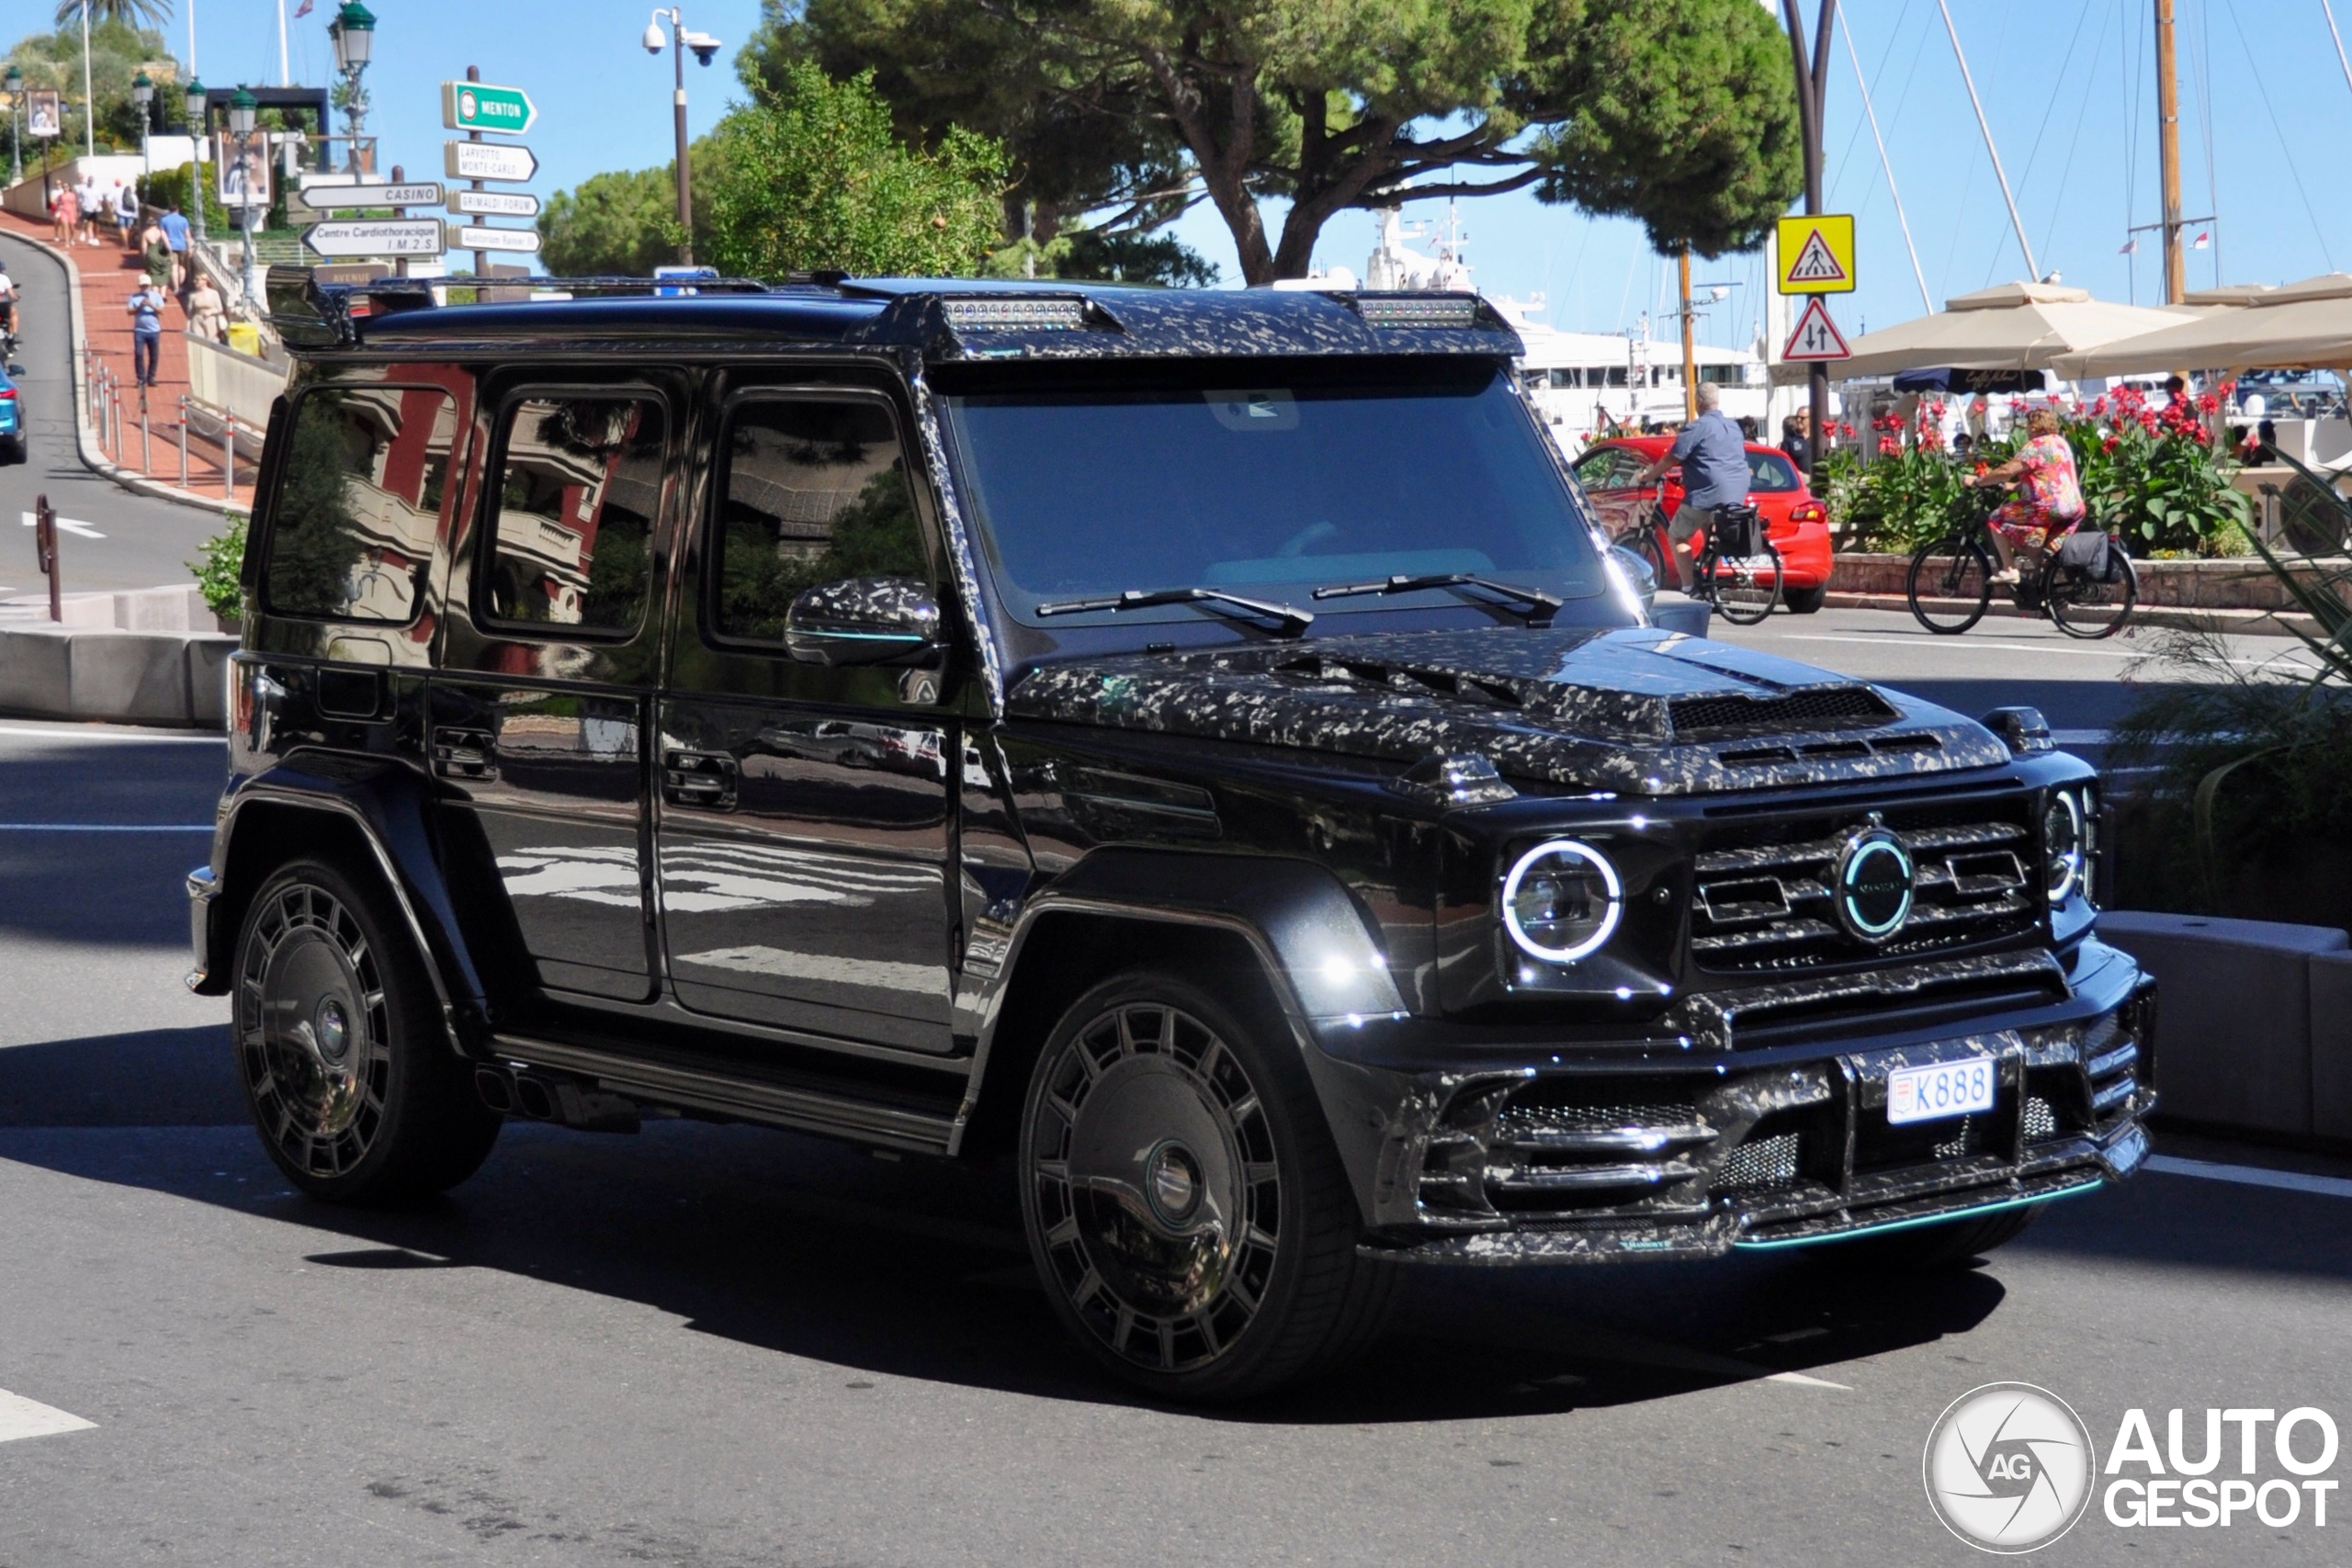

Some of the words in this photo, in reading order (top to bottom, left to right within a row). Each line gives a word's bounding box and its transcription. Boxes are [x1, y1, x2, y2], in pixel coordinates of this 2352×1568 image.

[481, 100, 521, 118] MENTON
[460, 147, 501, 160] LARVOTTO
[461, 161, 516, 175] MONTE-CARLO
[386, 188, 435, 201] CASINO
[462, 196, 501, 209] GRIMALDI
[503, 198, 531, 210] FORUM
[316, 228, 350, 239] Centre
[352, 226, 435, 240] Cardiothoracique
[387, 239, 436, 251] I.M.2.S.
[333, 272, 371, 283] AVENUE
[1917, 1066, 1985, 1111] K888
